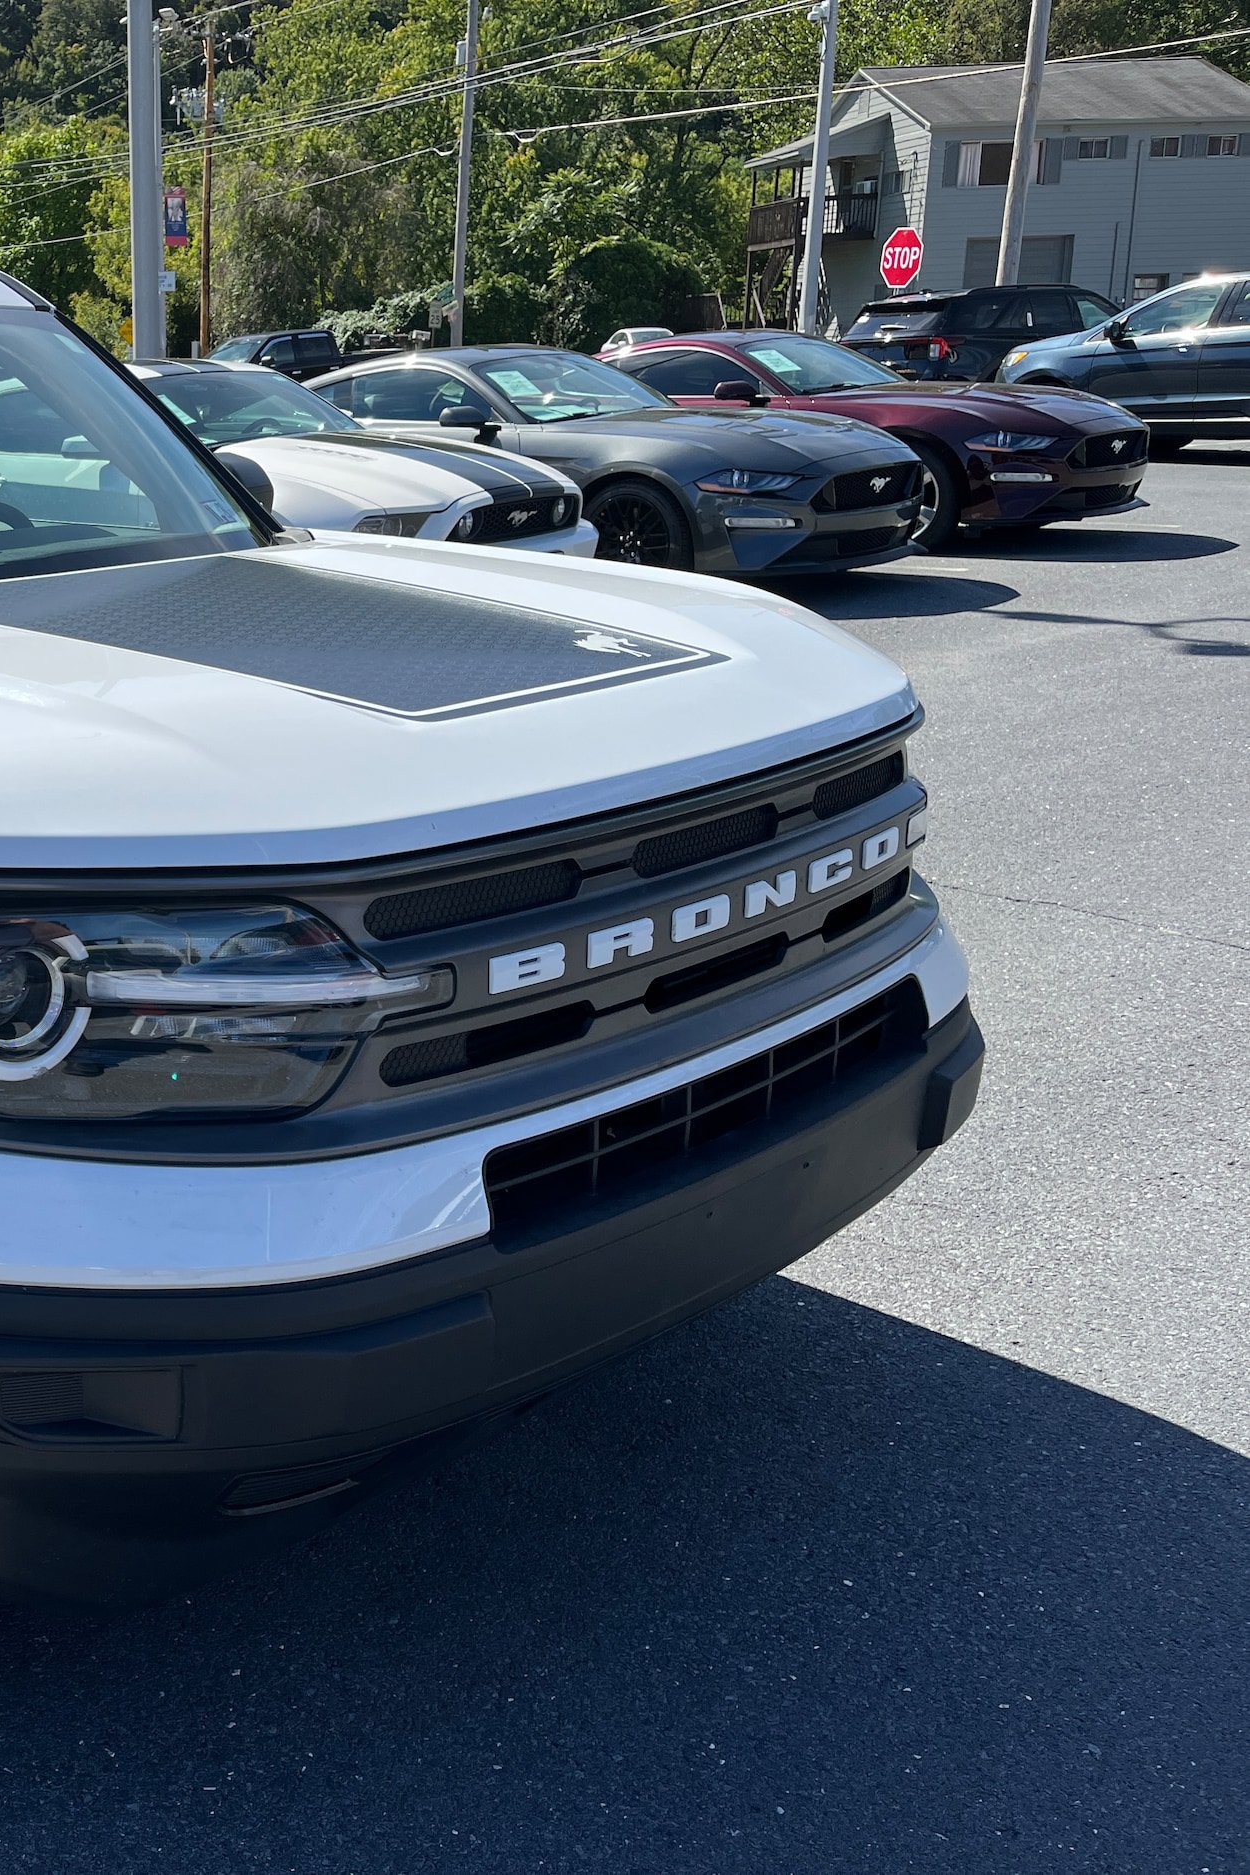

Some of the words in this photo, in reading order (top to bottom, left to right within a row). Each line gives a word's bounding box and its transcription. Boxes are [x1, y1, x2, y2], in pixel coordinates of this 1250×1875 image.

[883, 246, 920, 269] STOP
[430, 314, 440, 325] 25
[488, 826, 900, 996] BRONCO
